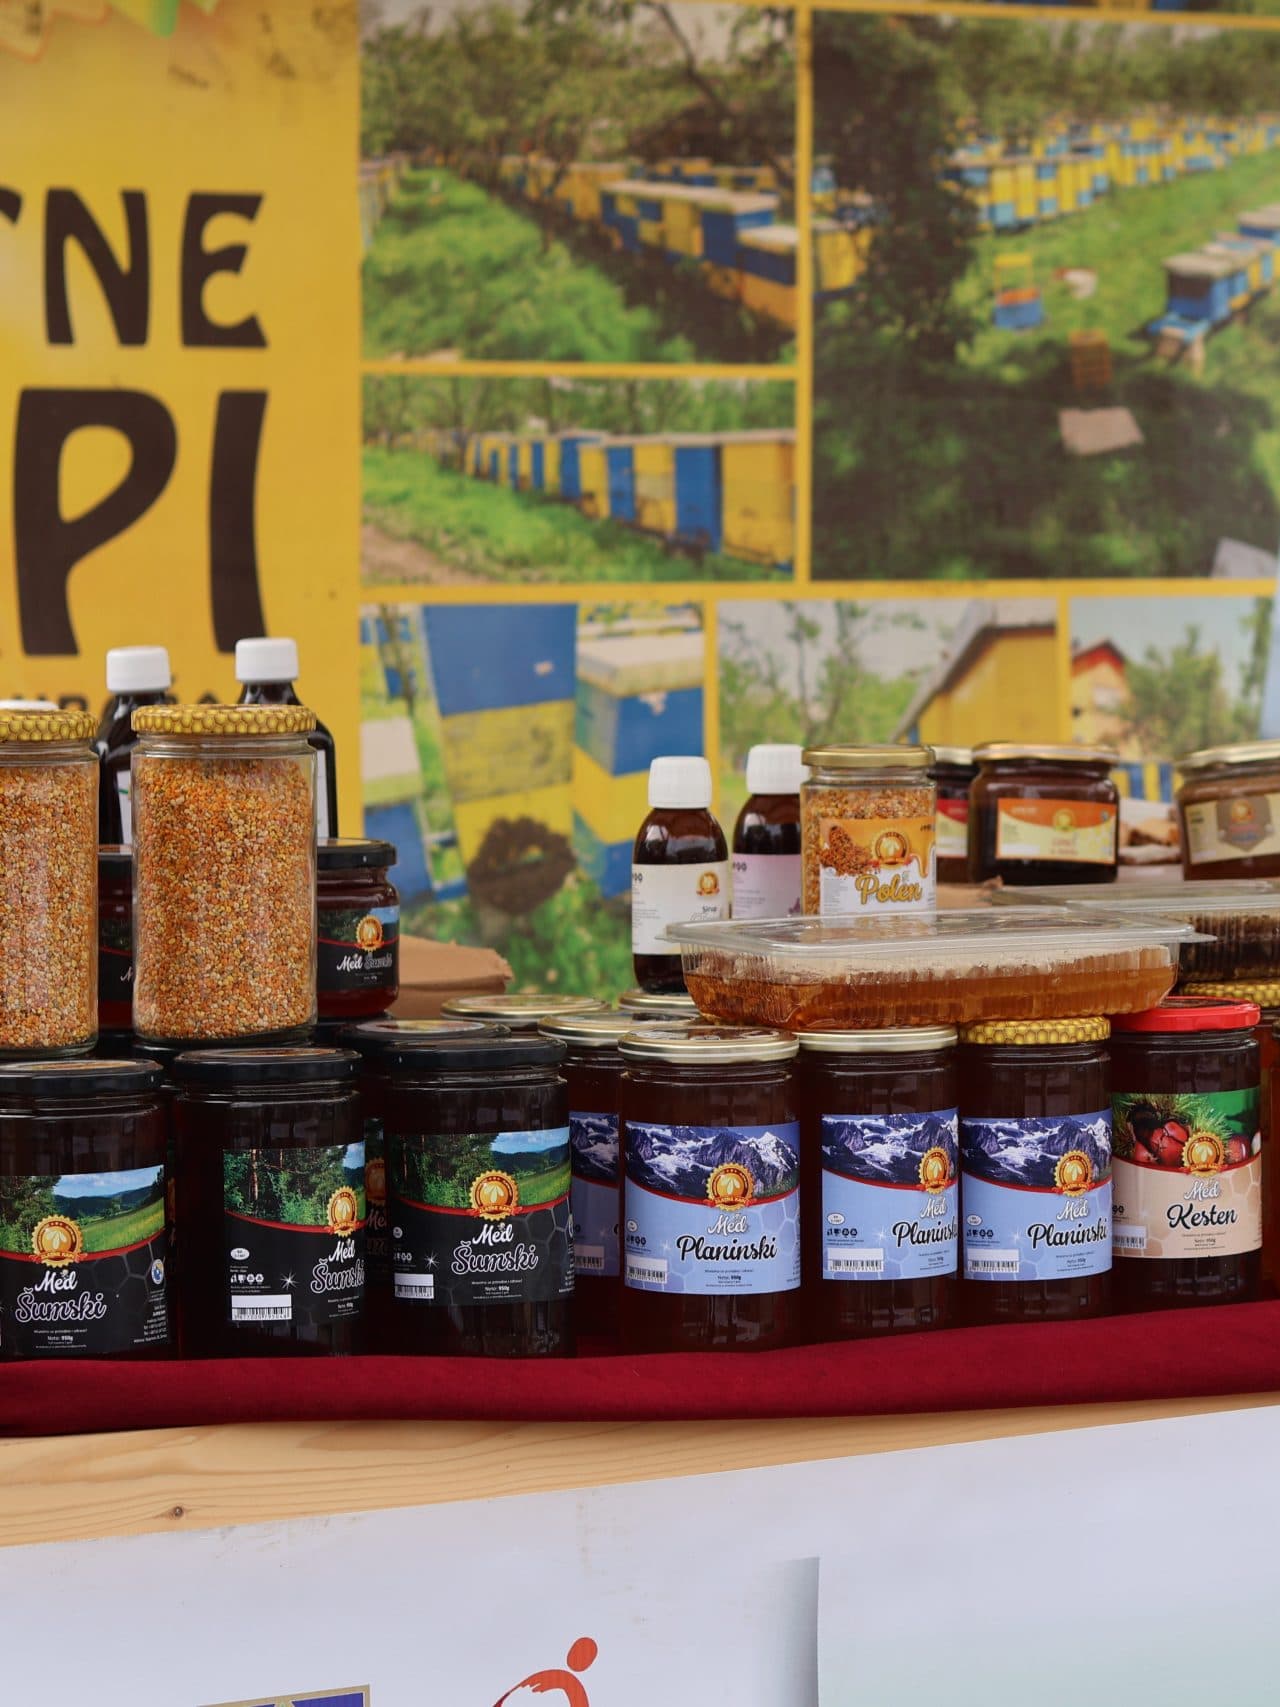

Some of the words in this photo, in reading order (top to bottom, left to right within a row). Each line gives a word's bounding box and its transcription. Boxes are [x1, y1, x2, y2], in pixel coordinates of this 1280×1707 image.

[0, 187, 270, 349] NE
[855, 874, 922, 905] Polen
[336, 953, 363, 973] Med
[1184, 1180, 1220, 1201] Med
[921, 1199, 946, 1218] Med
[1057, 1199, 1089, 1221] Med
[1166, 1203, 1237, 1229] Kesten
[472, 1223, 514, 1246] Med
[707, 1213, 748, 1236] Med
[1027, 1219, 1107, 1249] Planinski
[328, 1239, 356, 1262] Med
[451, 1241, 539, 1275] Šumski
[677, 1235, 778, 1262] Planinski
[34, 1269, 79, 1294] Med
[310, 1258, 365, 1293] Šumski
[15, 1287, 107, 1323] Šumski
